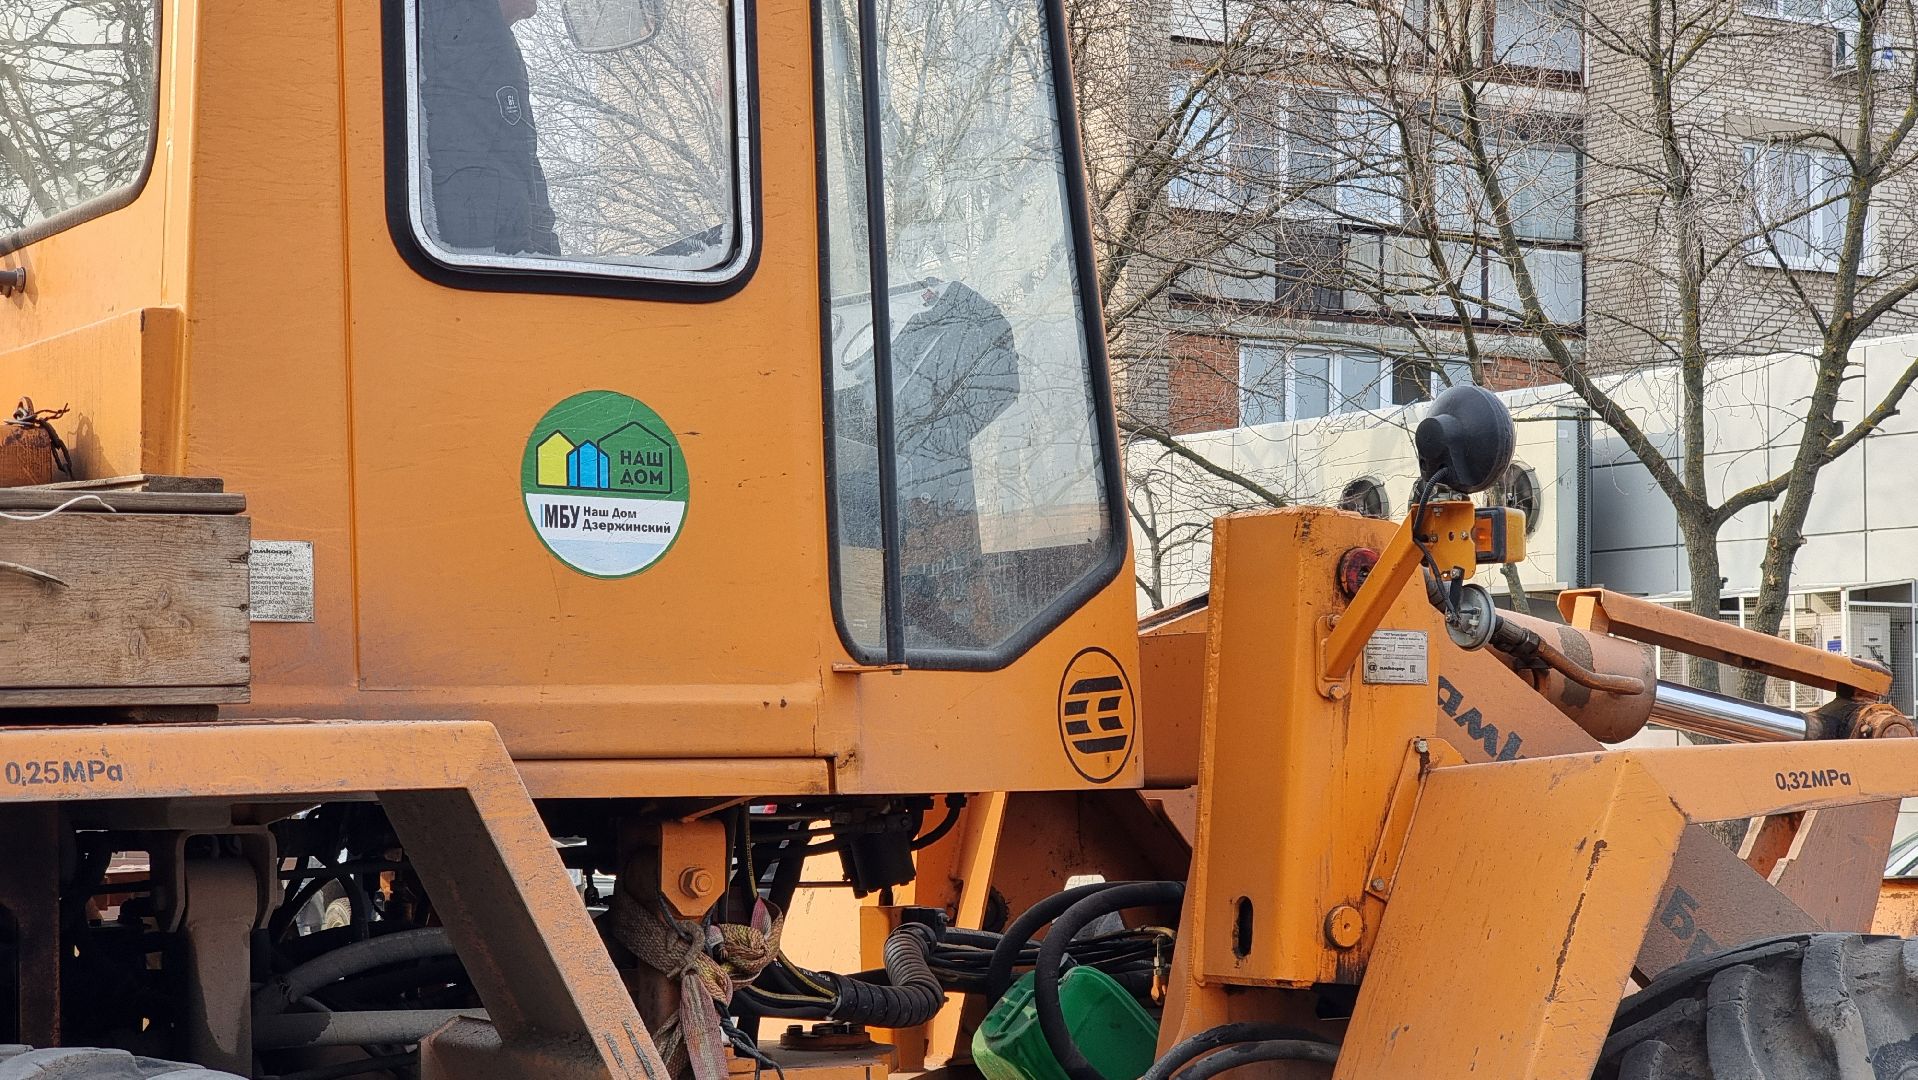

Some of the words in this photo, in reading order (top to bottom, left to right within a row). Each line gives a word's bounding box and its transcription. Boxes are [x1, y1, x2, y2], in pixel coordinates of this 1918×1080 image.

[620, 450, 663, 467] НАШ
[620, 469, 663, 485] ДОМ
[544, 503, 580, 529] МБУ
[583, 506, 609, 517] Наш
[612, 508, 637, 519] Дом
[582, 519, 671, 534] Дзержинский
[5, 760, 124, 786] 0,25MPa
[1775, 769, 1852, 791] 0,32MPa
